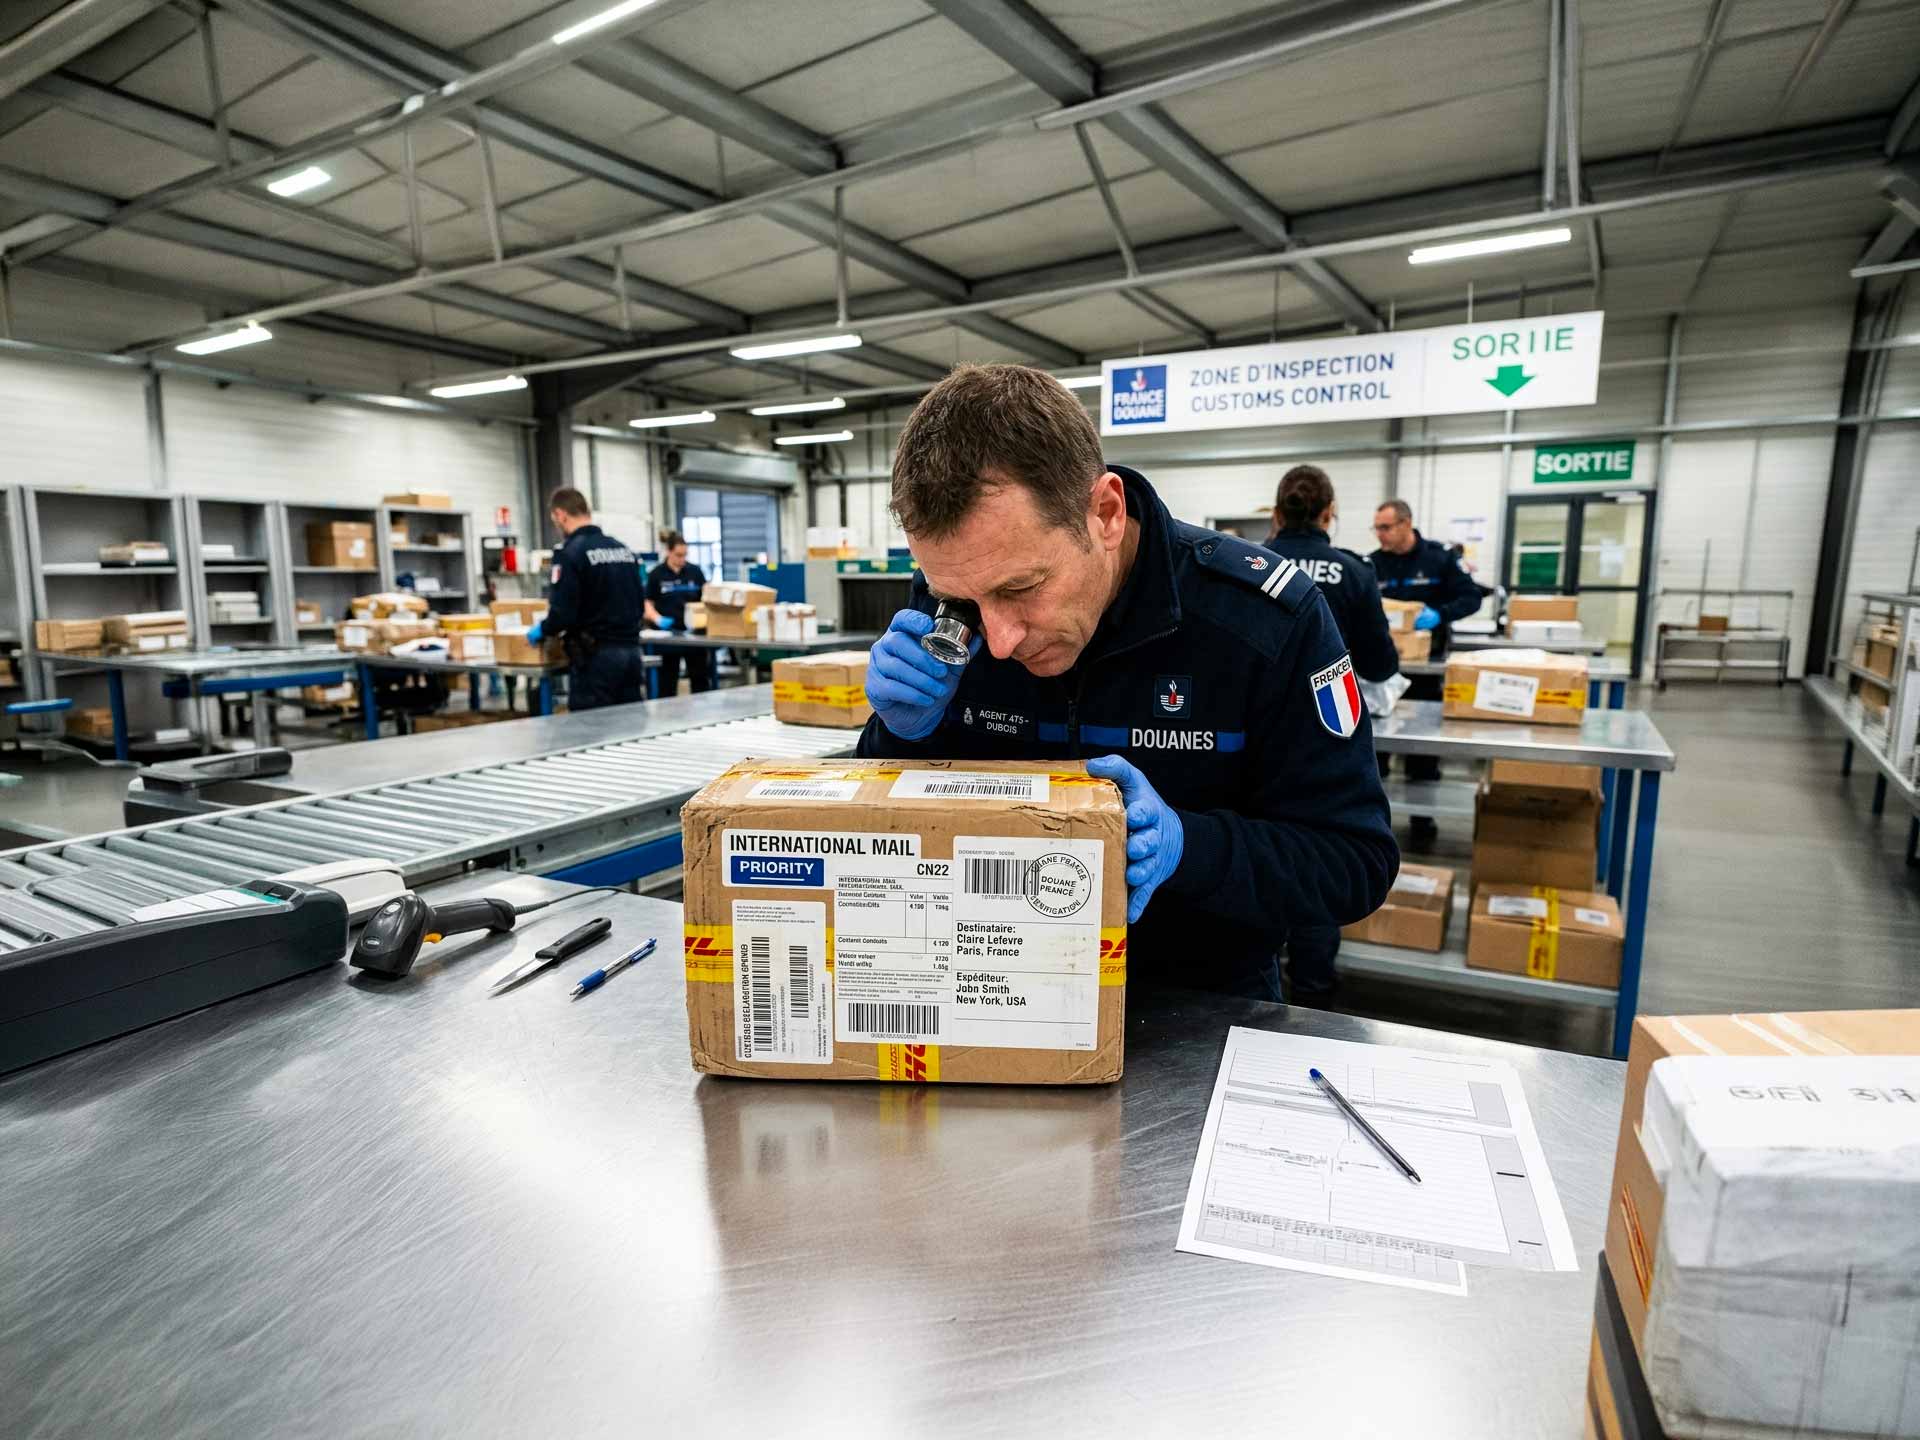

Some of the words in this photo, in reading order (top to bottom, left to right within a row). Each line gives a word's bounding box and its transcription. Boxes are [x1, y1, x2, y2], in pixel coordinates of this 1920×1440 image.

[1190, 366, 1240, 387] ZONE
[1113, 389, 1164, 406] FRANCE
[1191, 389, 1285, 413] CUSTOMS
[1292, 382, 1391, 406] CONTROL
[1113, 404, 1164, 420] DOUANE
[1536, 450, 1630, 475] SORTIE
[979, 709, 1008, 721] AGENT
[1132, 728, 1215, 750] DOUANES
[730, 834, 866, 855] INTERNATIONAL
[872, 838, 915, 856] MAIL
[739, 860, 815, 875] PRIORITY
[917, 862, 949, 876] CN22
[957, 922, 1016, 934] Destinataire:
[957, 934, 985, 945] Claire
[987, 935, 1023, 946] Lefevre
[956, 945, 984, 957] Paris,
[987, 946, 1020, 957] France
[956, 972, 1009, 983] Expéditeur:
[982, 984, 1010, 995] Smith
[956, 995, 977, 1004] New
[980, 996, 1004, 1006] York,
[1006, 996, 1027, 1006] USA
